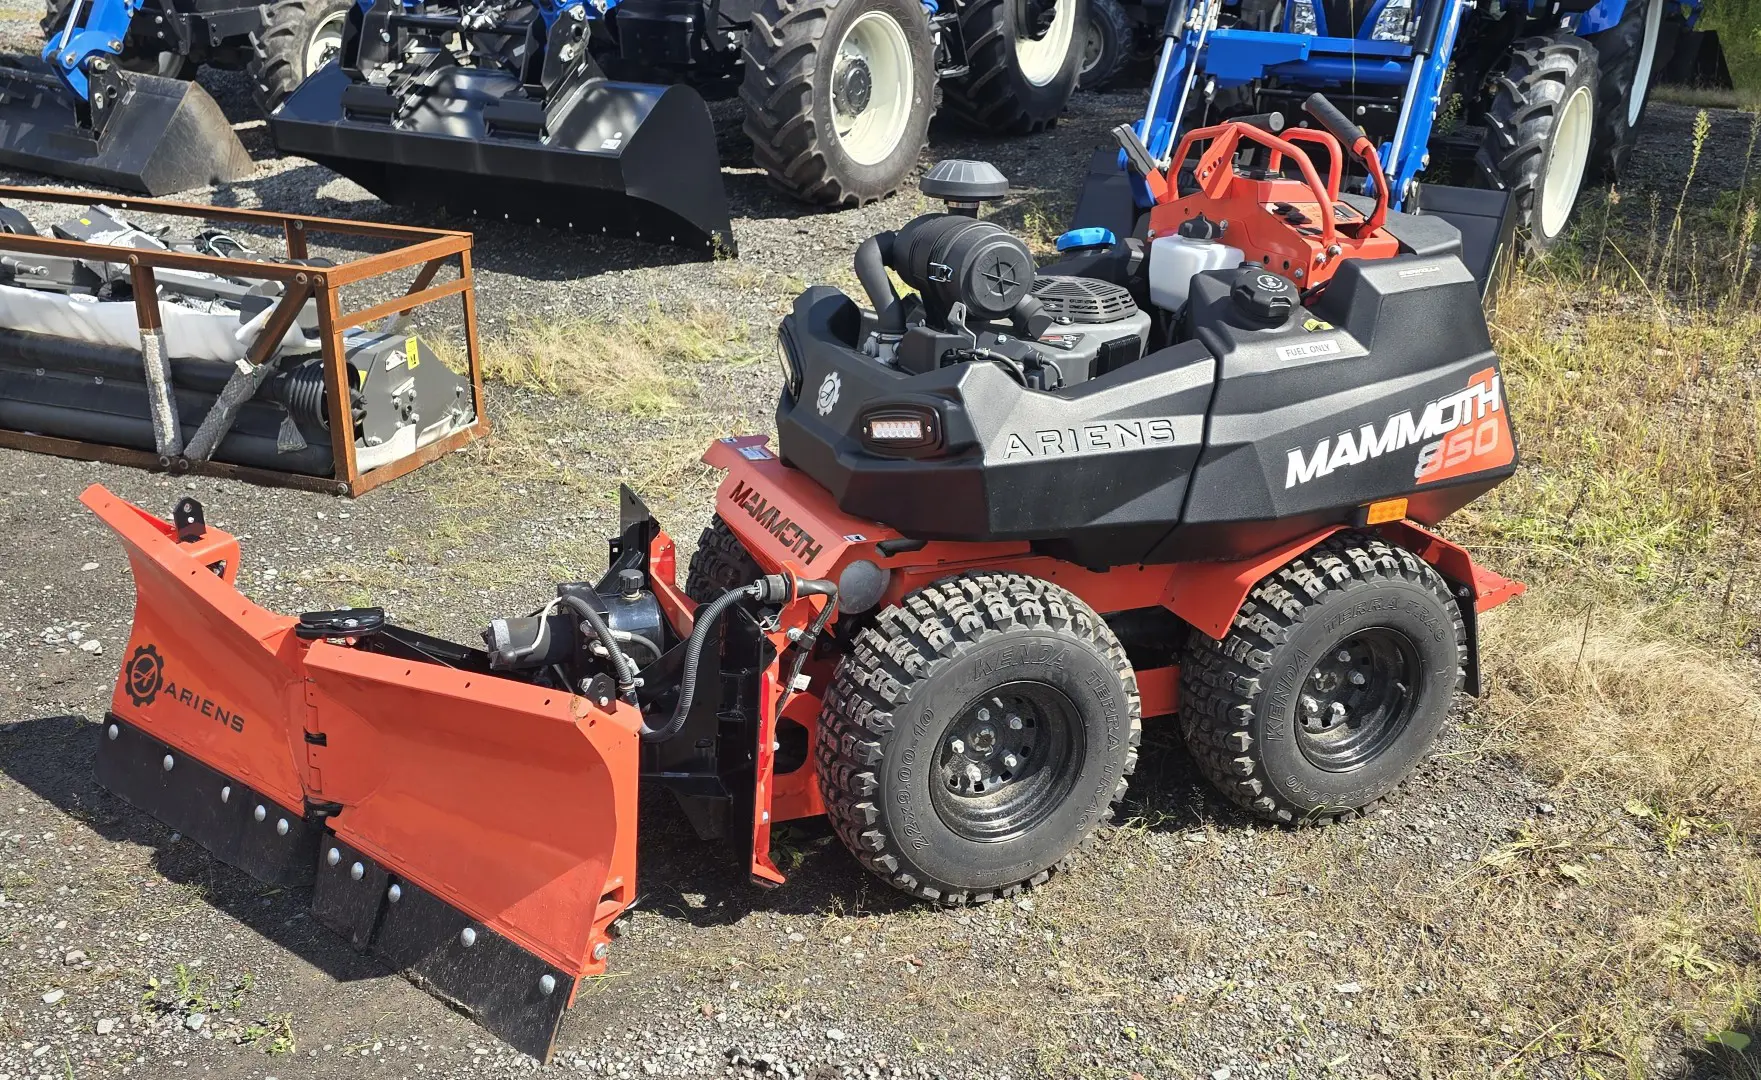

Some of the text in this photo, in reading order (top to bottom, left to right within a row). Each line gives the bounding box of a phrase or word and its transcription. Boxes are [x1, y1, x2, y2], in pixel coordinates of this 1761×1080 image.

[1285, 343, 1330, 357] FUEL ONLY
[1003, 419, 1175, 459] ARIENS
[1285, 373, 1500, 489] MAMMOTH
[1414, 418, 1498, 478] 850
[729, 480, 823, 565] MAMMOTH
[1323, 597, 1446, 642] TERRA TRAC
[974, 643, 1071, 681] KENDA
[164, 682, 244, 733] ARIENS
[1266, 648, 1310, 741] KENDA
[1076, 669, 1120, 831] TERRA TRAC
